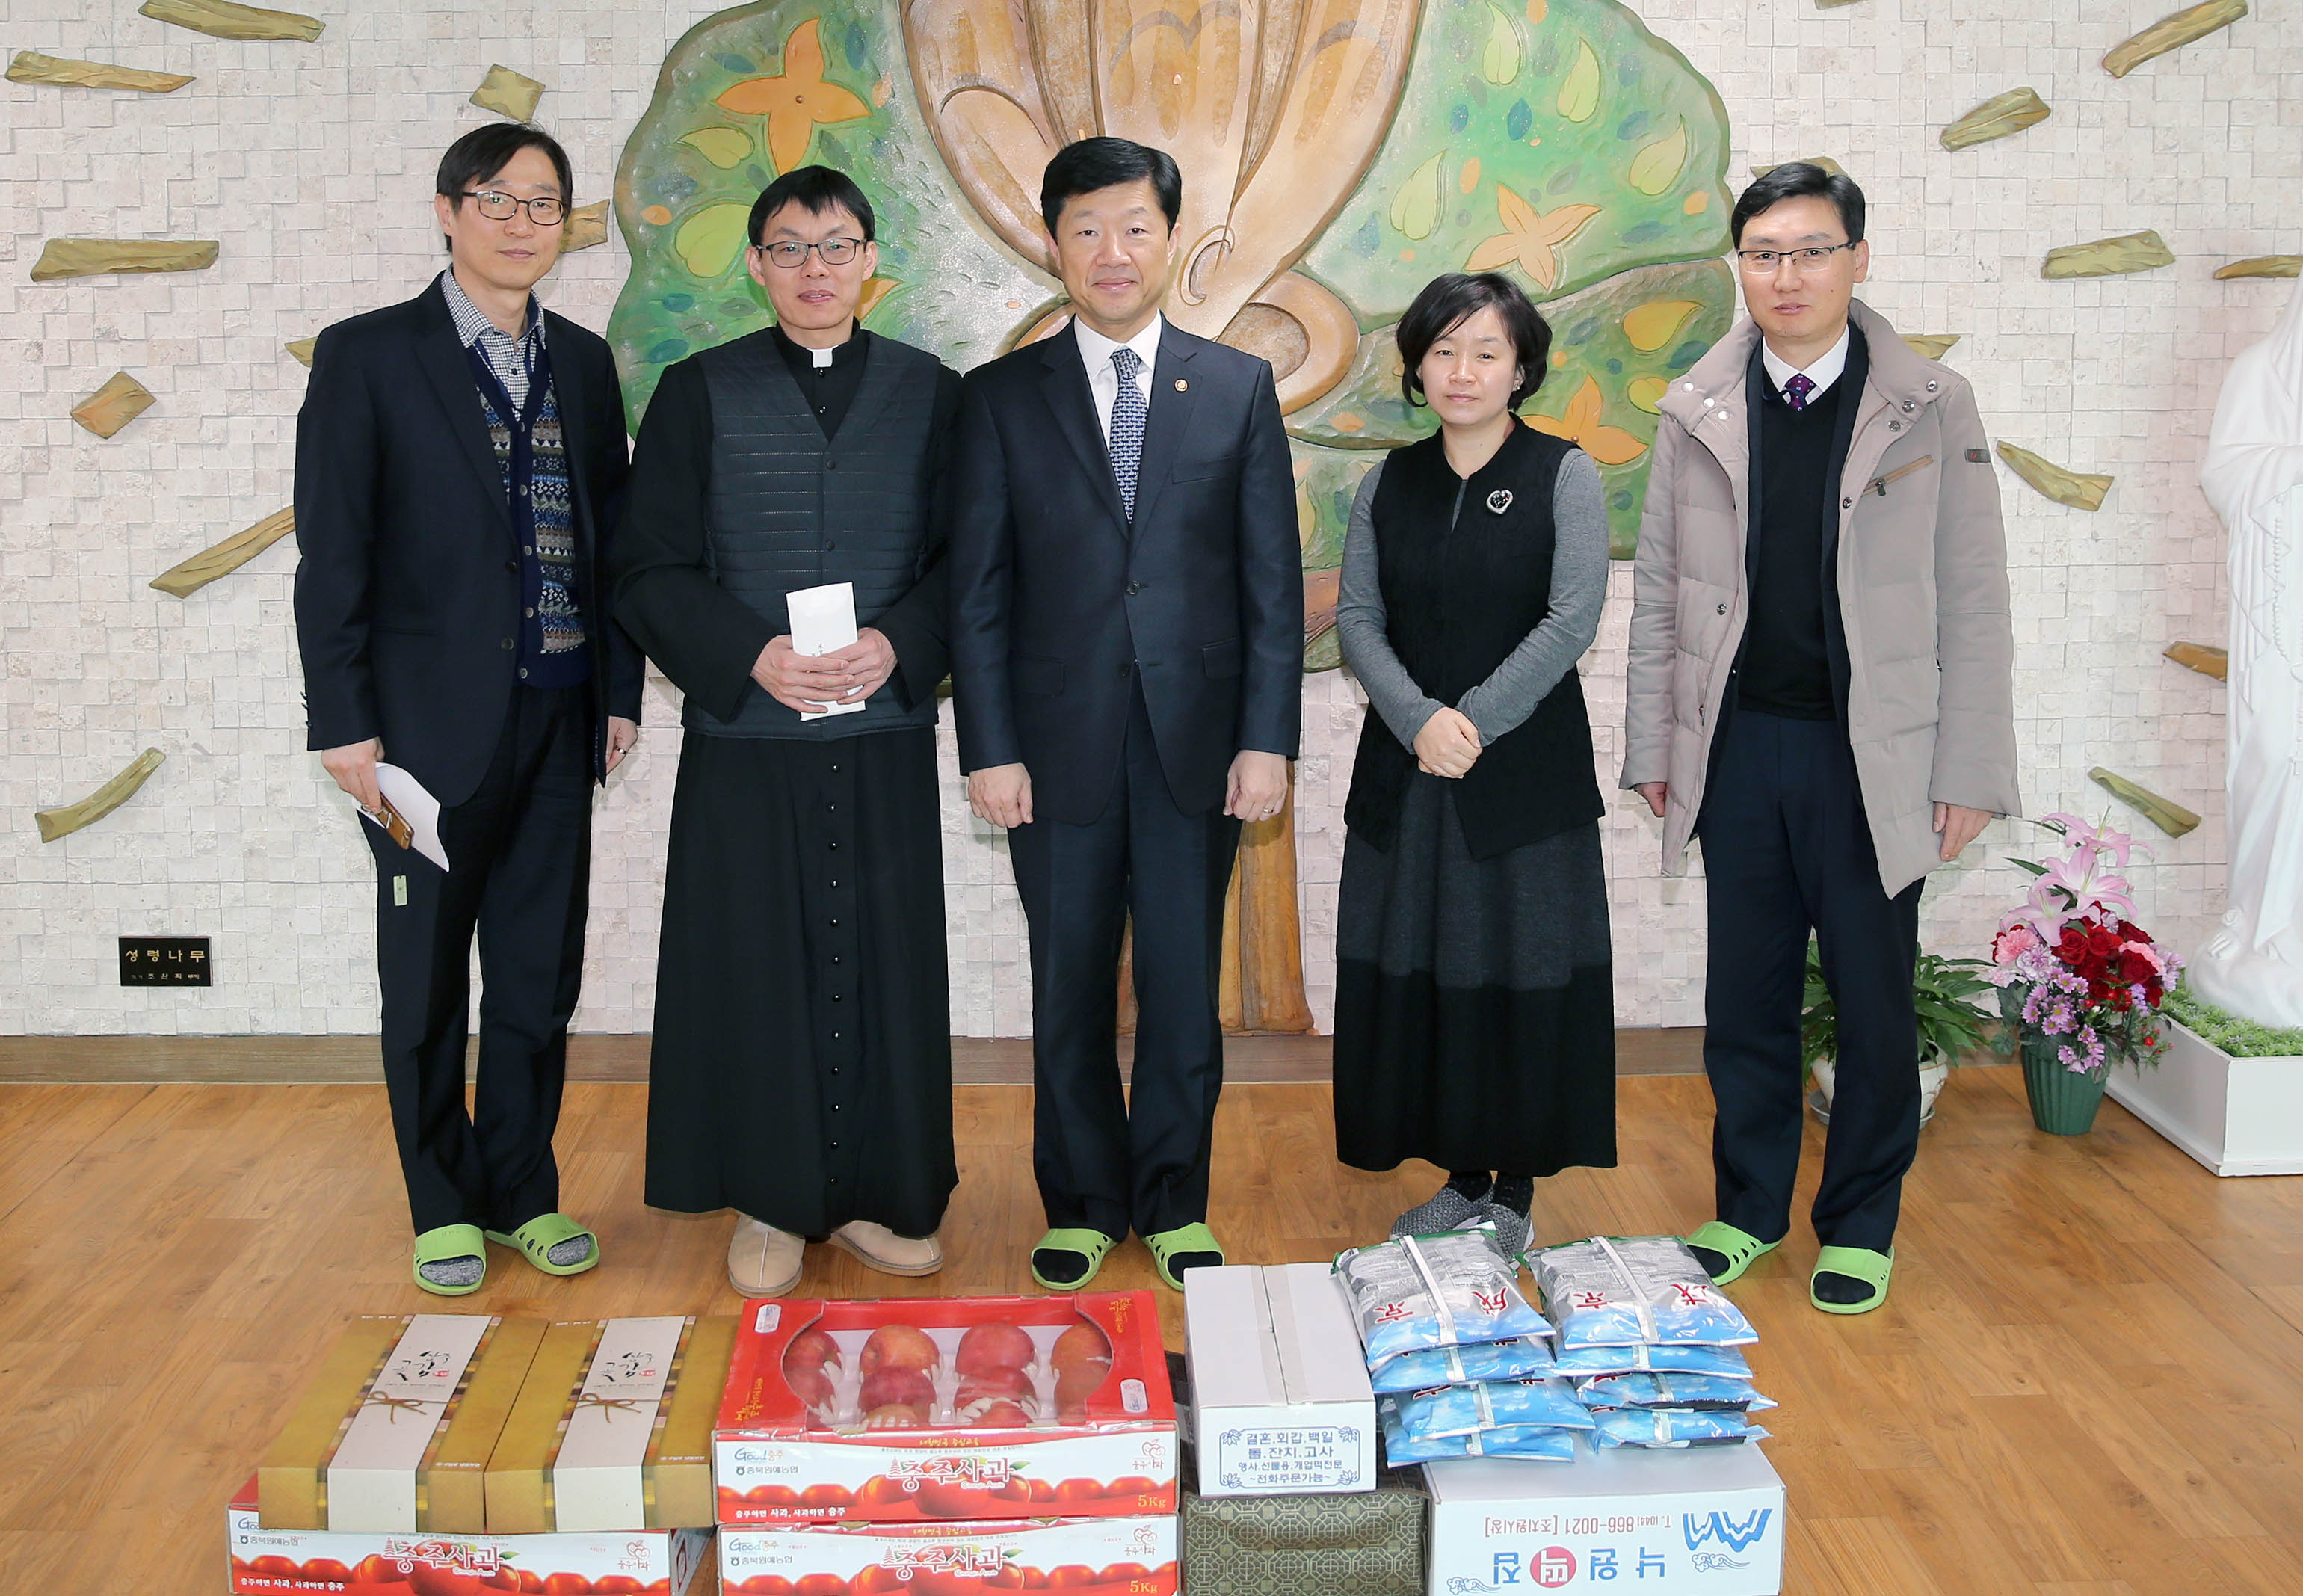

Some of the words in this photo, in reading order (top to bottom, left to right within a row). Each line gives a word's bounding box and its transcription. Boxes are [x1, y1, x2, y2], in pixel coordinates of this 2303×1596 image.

[1471, 1287, 1507, 1316] 成
[1573, 1292, 1612, 1309] 京
[1373, 1301, 1413, 1324] 京
[887, 1457, 1014, 1491] 충주사과
[1138, 1495, 1166, 1508] 5Kg
[735, 1509, 767, 1518] 충주하면
[771, 1508, 792, 1518] 사과,
[794, 1508, 824, 1518] 사과하면
[828, 1506, 846, 1516] 충주
[1485, 1517, 1559, 1537] [조치원시장]
[1564, 1517, 1634, 1534] 866-0021
[382, 1538, 502, 1573] 충주사과
[881, 1546, 1008, 1580] 충주사과
[241, 1577, 271, 1588] 충주하면
[274, 1579, 293, 1589] 사과,
[295, 1580, 324, 1590] 사과하면
[328, 1581, 345, 1592] 충주
[1130, 1580, 1158, 1593] 5Kg
